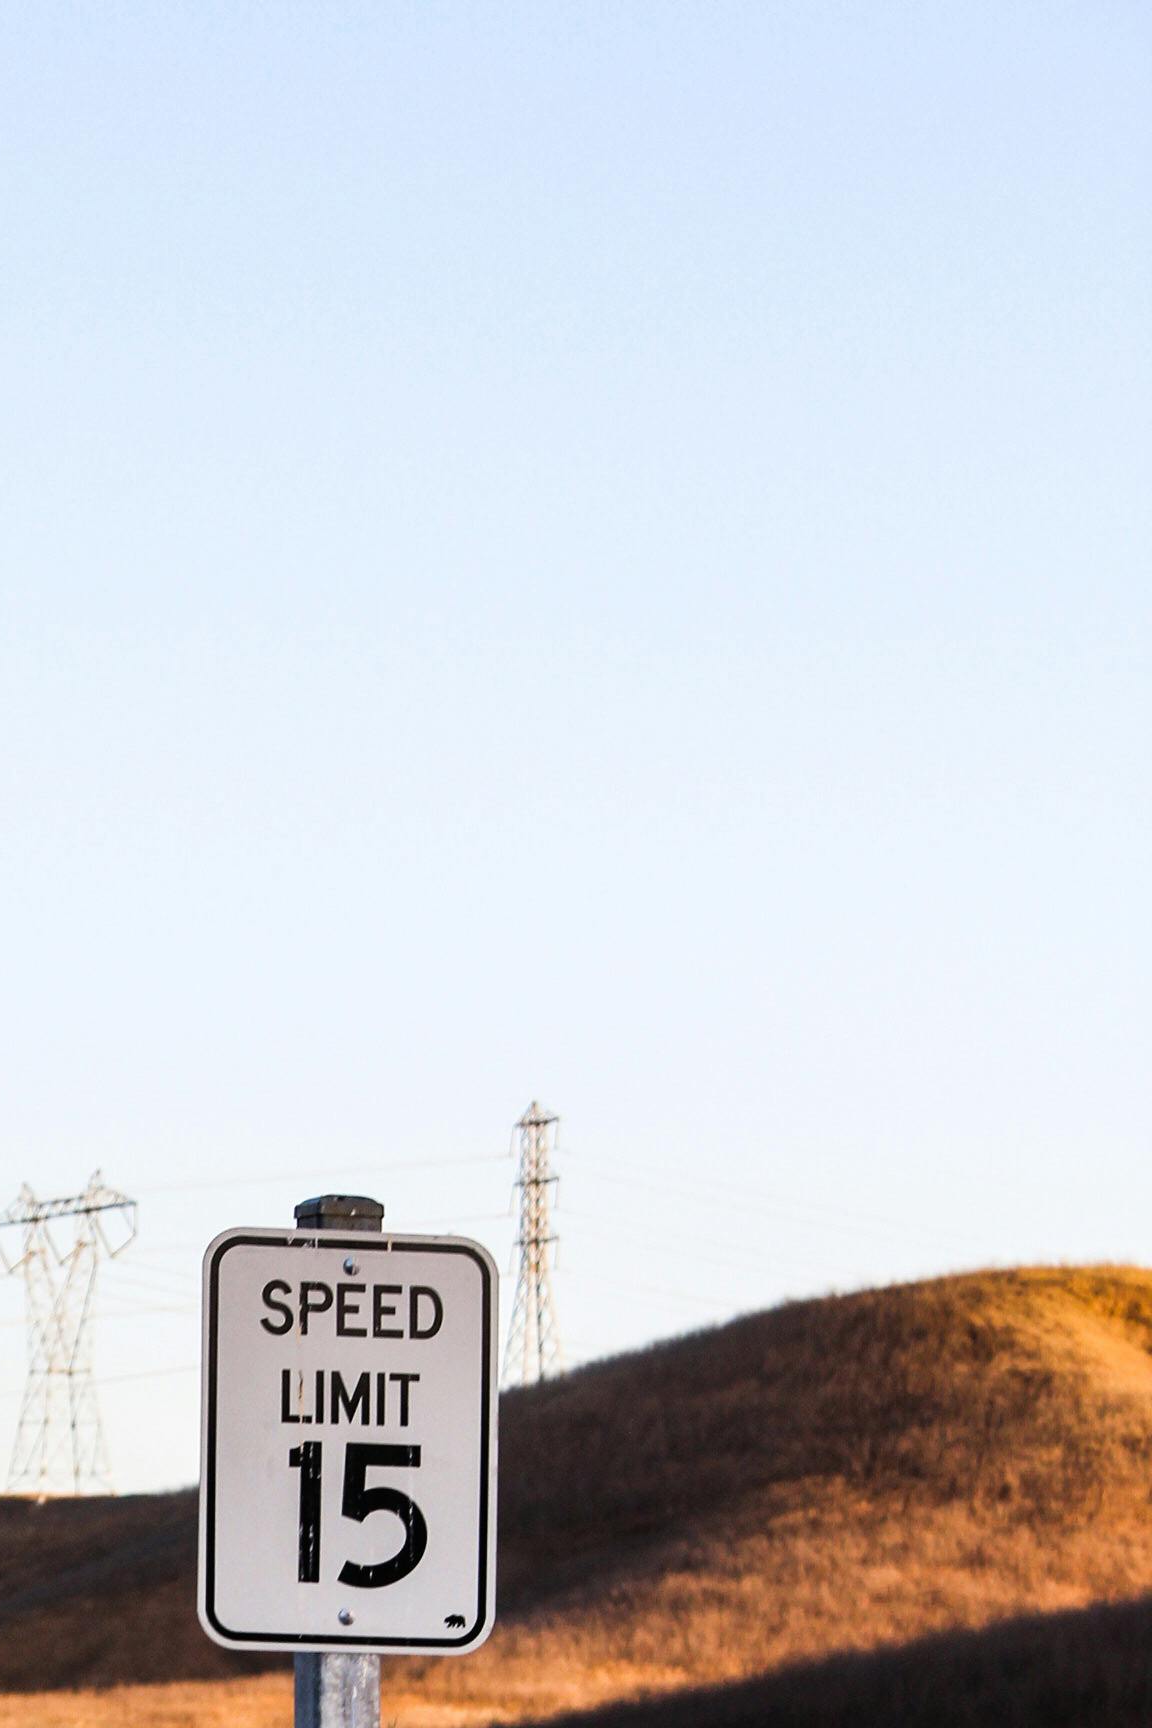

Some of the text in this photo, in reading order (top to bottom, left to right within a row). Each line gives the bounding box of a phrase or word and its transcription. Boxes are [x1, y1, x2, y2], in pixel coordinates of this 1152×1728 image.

[260, 1279, 443, 1339] SPEED
[281, 1369, 420, 1426] LIMIT
[289, 1441, 428, 1588] 15
